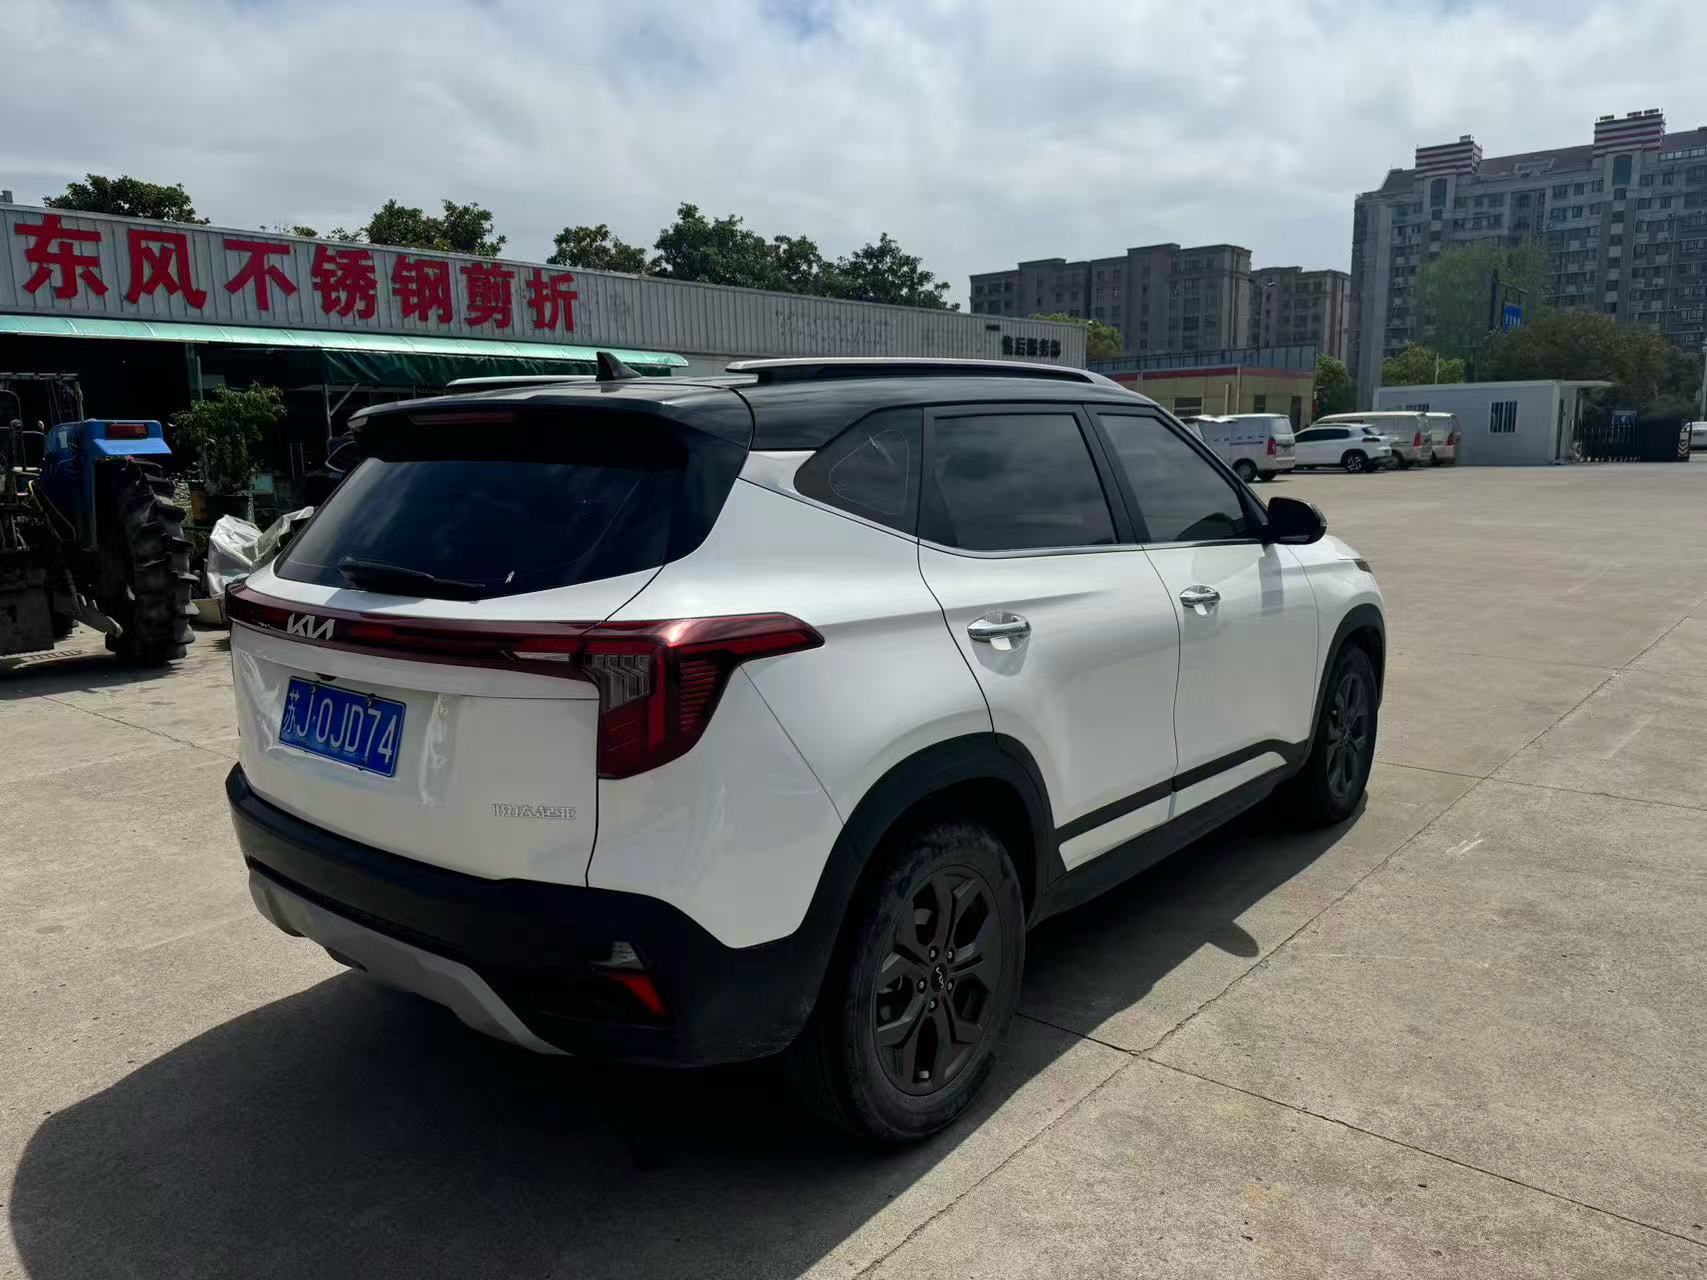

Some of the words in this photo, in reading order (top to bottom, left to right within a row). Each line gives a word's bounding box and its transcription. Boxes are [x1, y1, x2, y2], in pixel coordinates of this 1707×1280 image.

[16, 214, 578, 332] 东风不锈钢剪折
